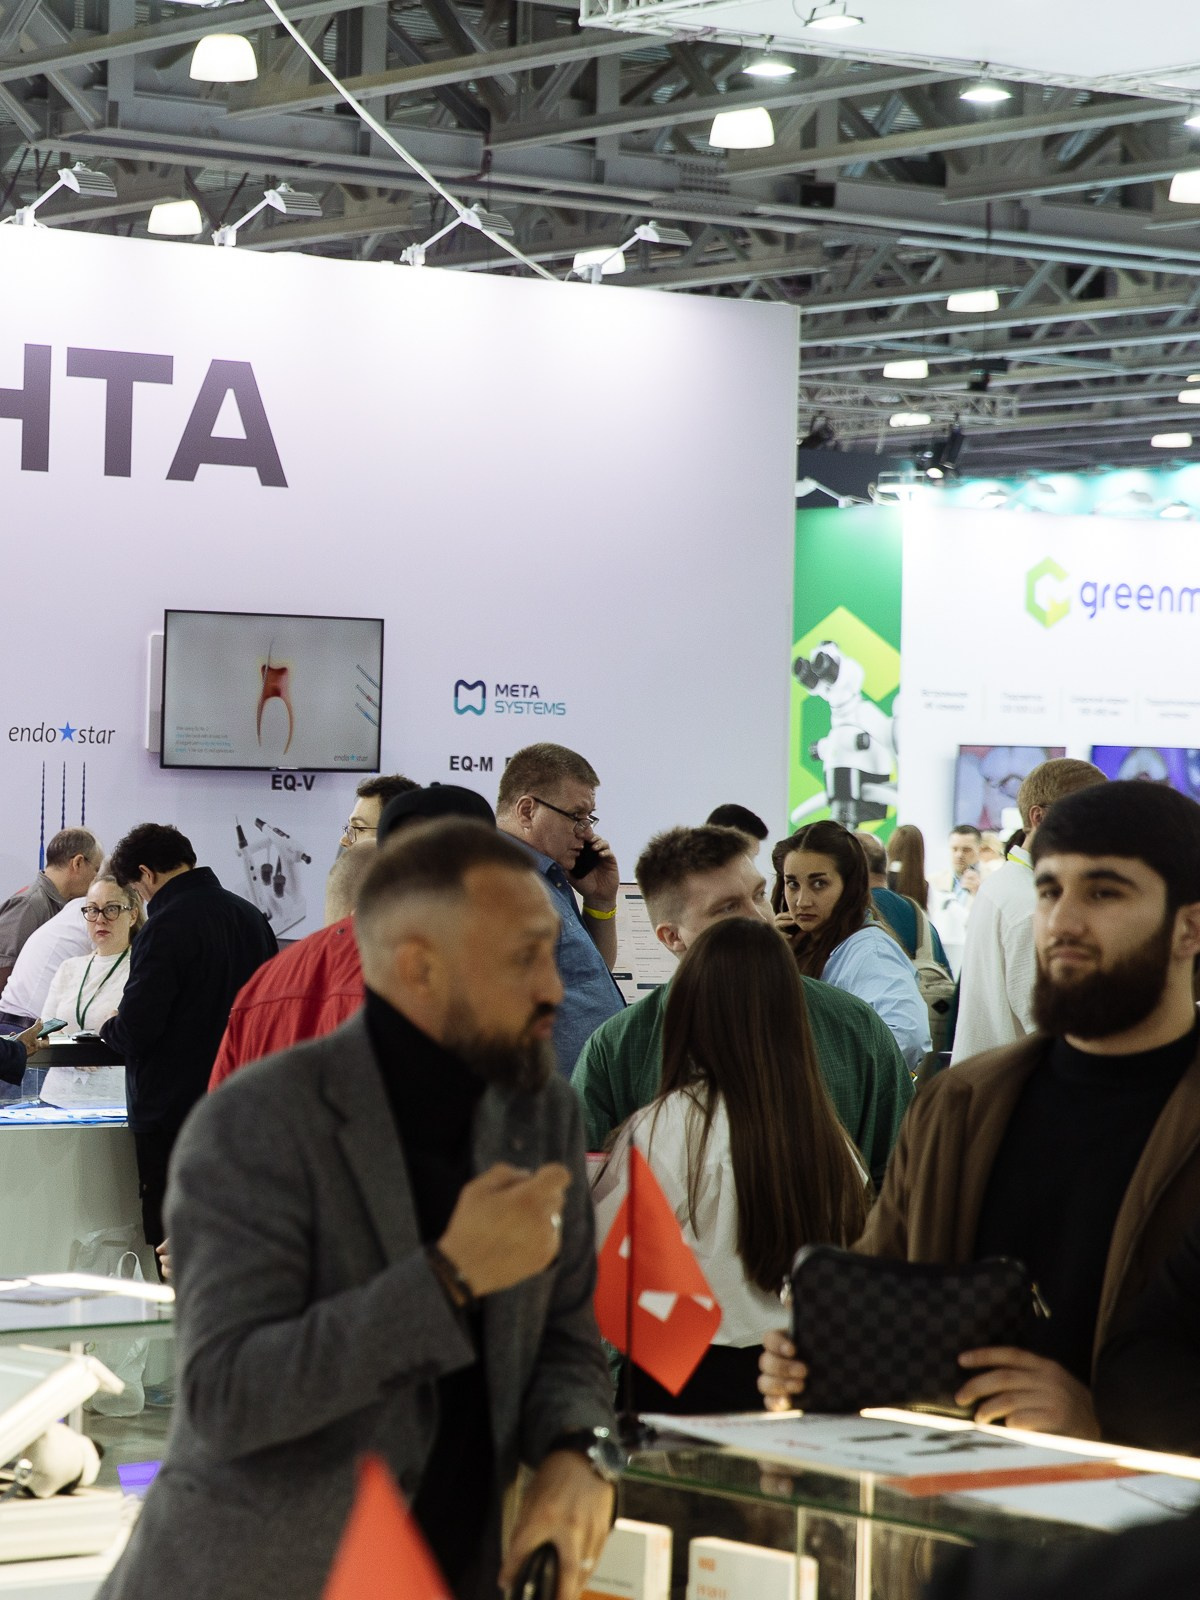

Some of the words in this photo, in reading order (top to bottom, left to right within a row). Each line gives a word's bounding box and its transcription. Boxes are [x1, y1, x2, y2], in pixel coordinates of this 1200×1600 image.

[495, 684, 540, 698] META
[494, 700, 567, 716] SYSTEMS
[449, 755, 493, 772] EQ-M
[271, 774, 316, 792] EQ-V
